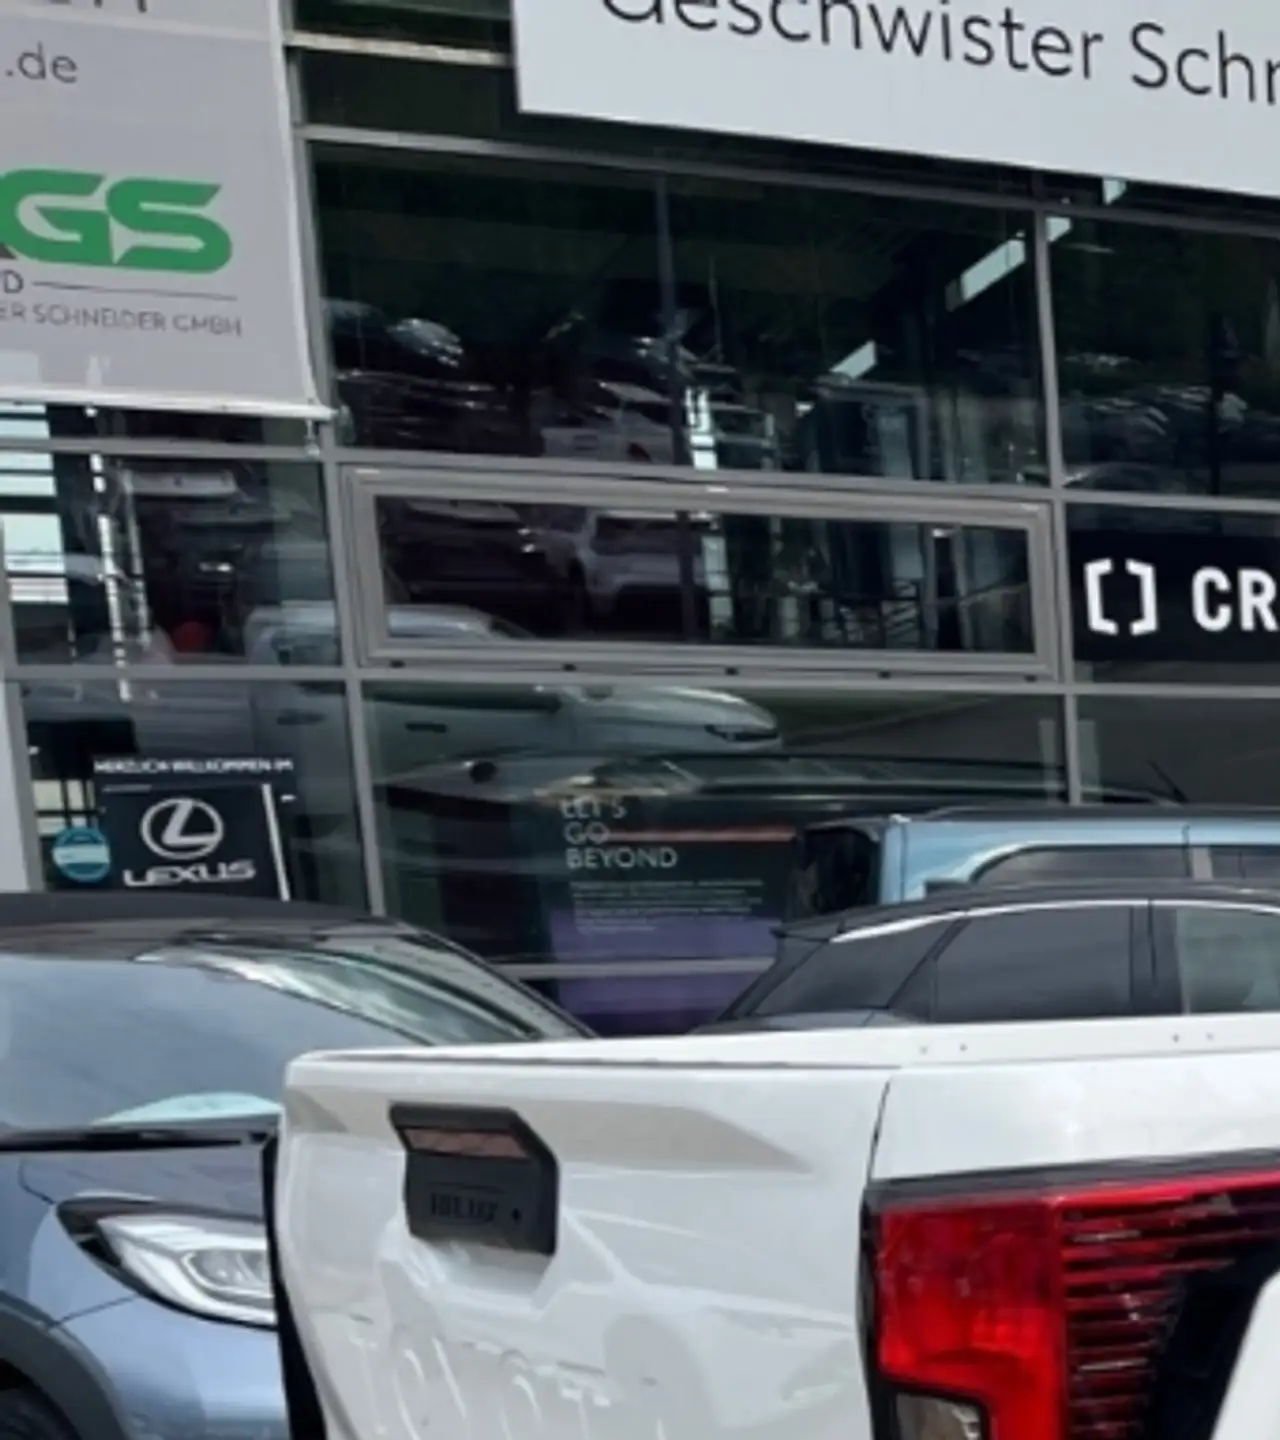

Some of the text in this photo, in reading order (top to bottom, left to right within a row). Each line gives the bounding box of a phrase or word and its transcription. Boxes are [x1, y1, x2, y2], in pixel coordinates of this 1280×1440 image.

[32, 303, 167, 333] SCHNEIDER
[564, 821, 611, 845] GO
[566, 847, 678, 868] BEYOND
[123, 859, 257, 887] LEXUS
